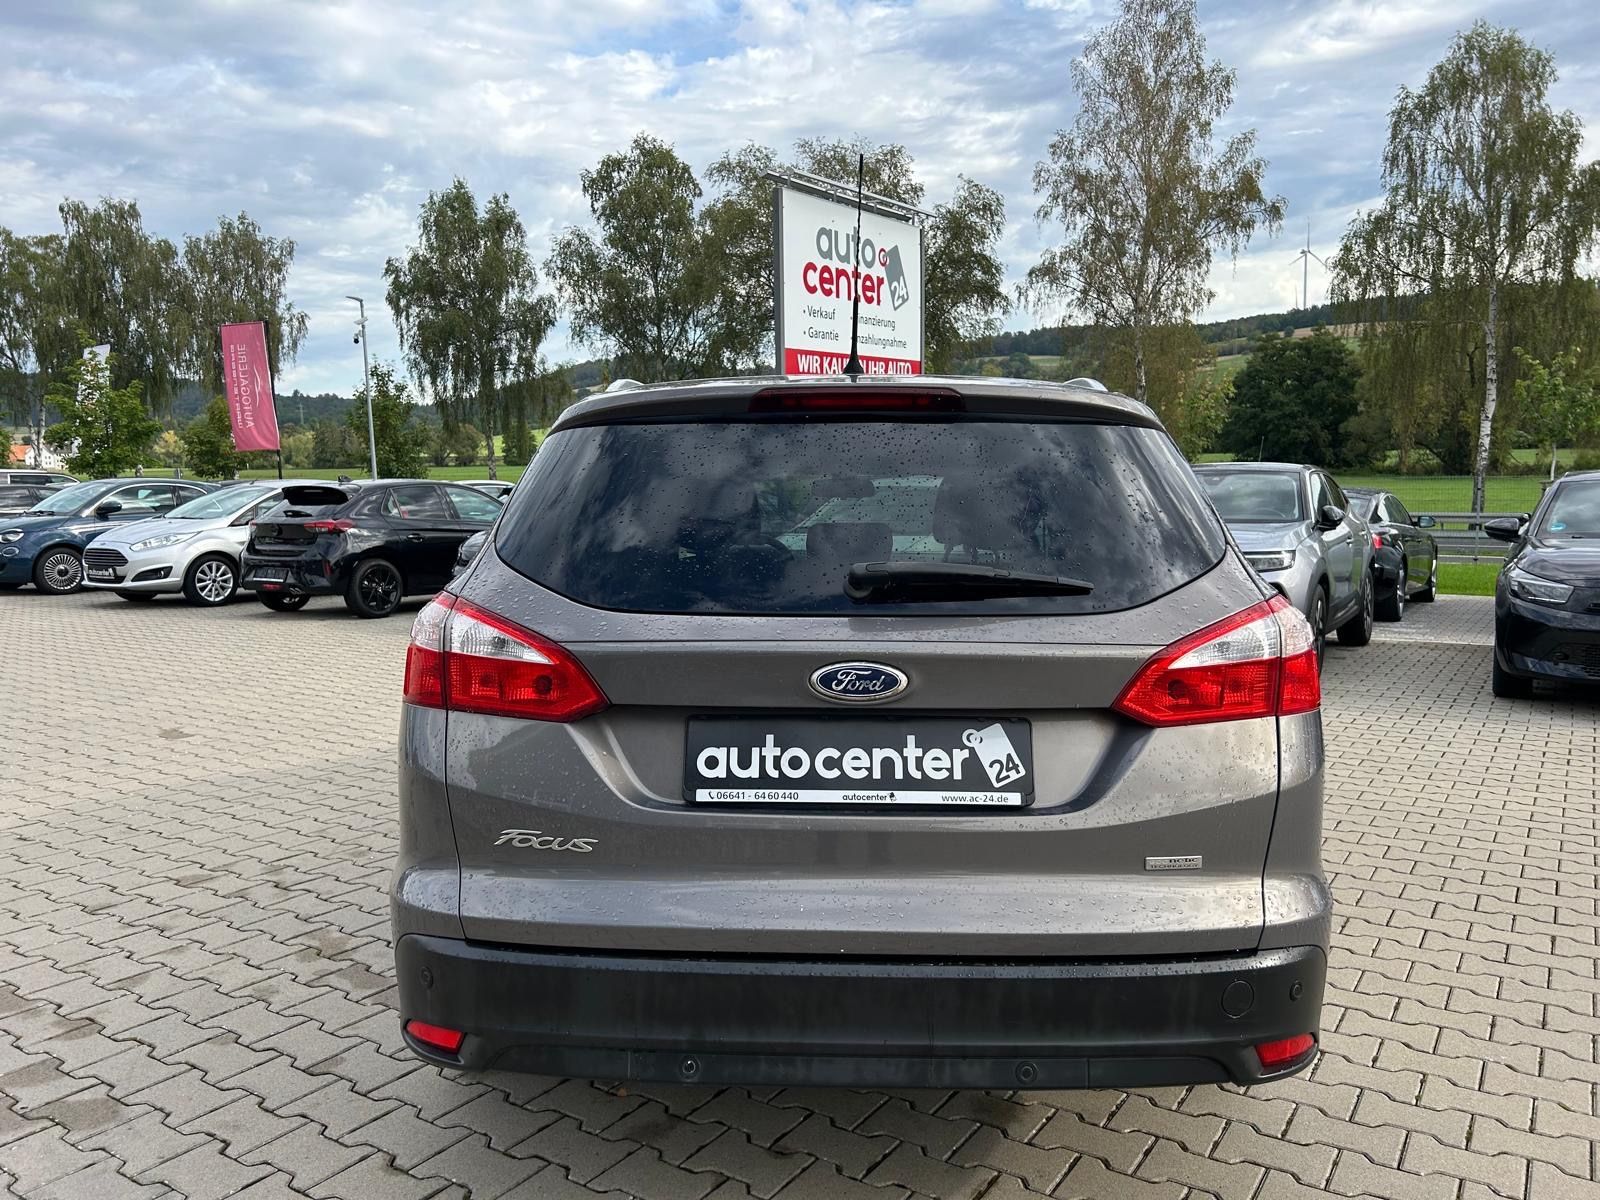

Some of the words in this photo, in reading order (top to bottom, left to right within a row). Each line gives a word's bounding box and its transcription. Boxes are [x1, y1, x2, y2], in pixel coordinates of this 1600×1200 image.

[816, 226, 876, 269] auto
[802, 262, 885, 306] center
[890, 276, 907, 303] 24
[807, 305, 836, 320] Verkauf
[808, 327, 839, 342] Garantie
[797, 353, 821, 374] WIR
[868, 360, 886, 375] IHR
[887, 361, 912, 375] AUTO
[831, 669, 886, 691] Ford
[988, 752, 1021, 785] 24
[716, 791, 745, 800] 06641
[842, 793, 887, 802] autocenter
[941, 793, 1010, 804] www.ac-24.de
